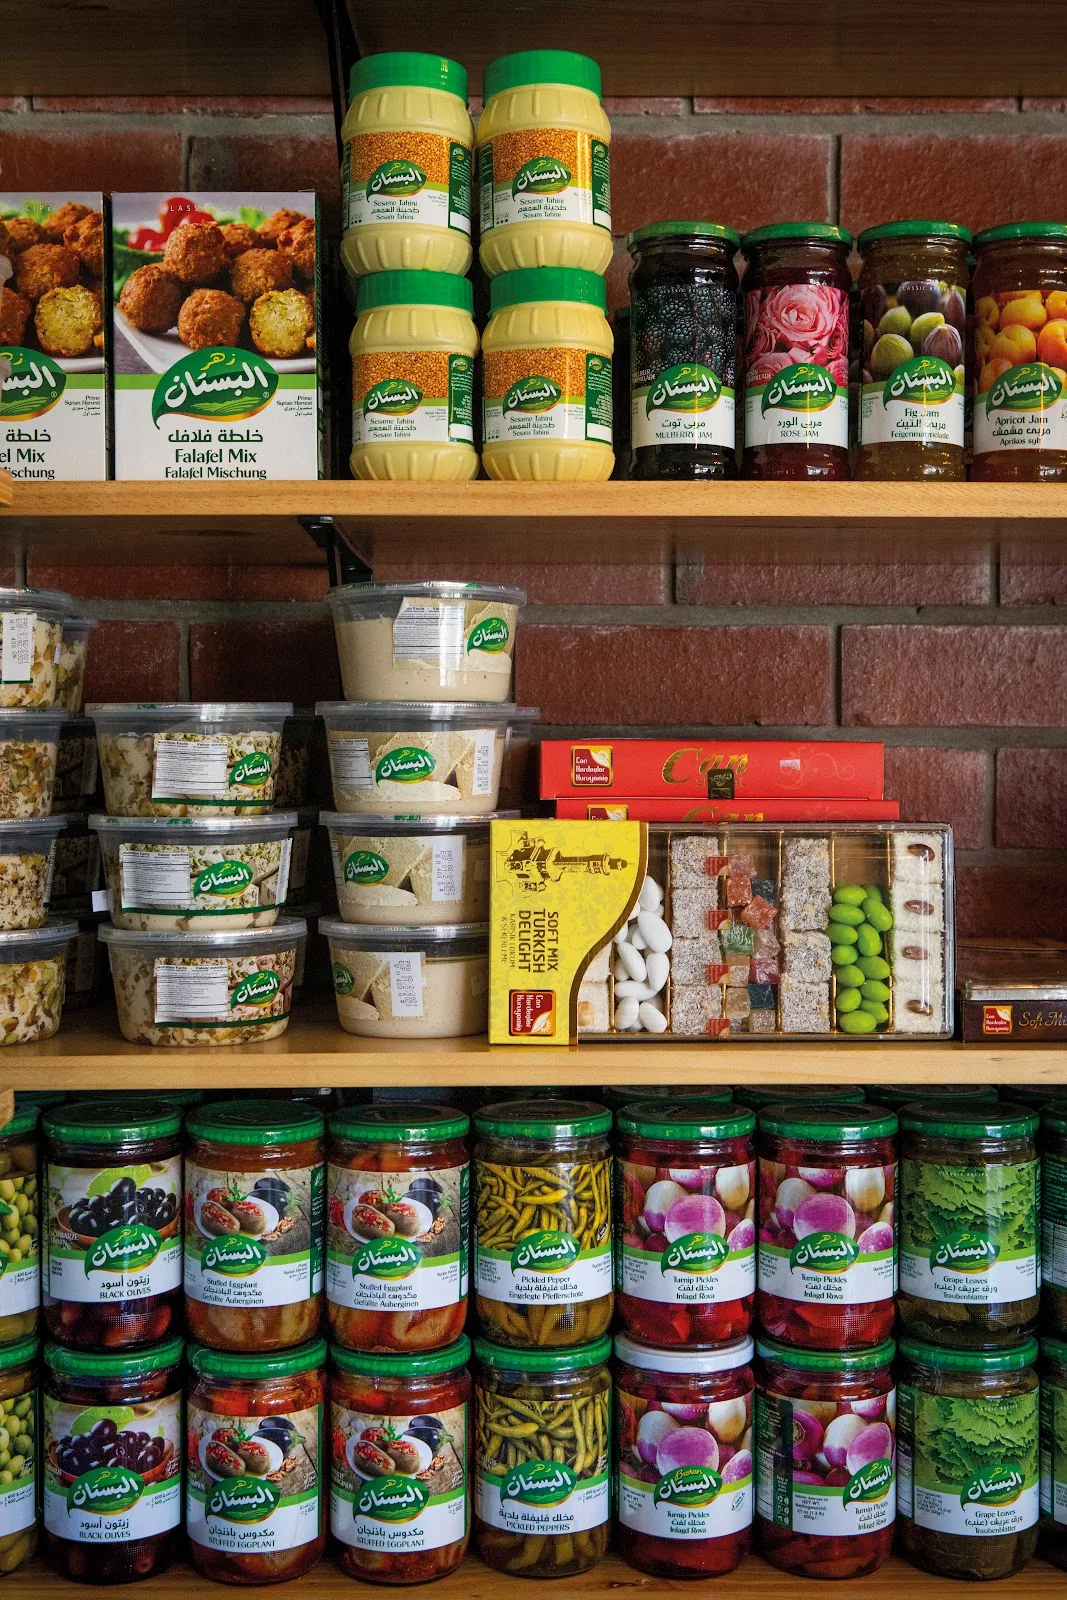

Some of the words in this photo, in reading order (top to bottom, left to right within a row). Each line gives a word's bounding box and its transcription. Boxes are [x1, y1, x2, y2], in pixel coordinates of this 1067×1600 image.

[371, 168, 421, 192] البستان
[517, 165, 567, 190] البستان
[518, 205, 540, 213] السمسم
[200, 352, 235, 371] زهر
[164, 362, 269, 408] البستان
[653, 375, 716, 405] البستان
[768, 376, 832, 404] البستان
[891, 367, 953, 396] البستان
[992, 374, 1058, 406] البستان
[368, 388, 418, 409] البستان
[508, 384, 557, 408] البستان
[905, 408, 918, 418] Fig
[995, 416, 1026, 425] Apricot
[1029, 416, 1047, 424] Jam
[6, 429, 51, 442] خلطة
[168, 429, 212, 442] فلافل
[219, 429, 263, 442] خلطة
[781, 430, 800, 438] ROSE
[803, 430, 818, 438] JAM
[1000, 438, 1026, 446] Aprikos
[17, 449, 45, 462] Mix
[175, 449, 222, 464] Falafel
[228, 449, 256, 462] Mix
[165, 467, 203, 479] Falafel
[208, 467, 266, 480] Mischung
[473, 626, 507, 646] البستان
[235, 762, 270, 782] البستان
[381, 757, 431, 777] البستان
[200, 867, 249, 891] البستان
[547, 912, 559, 945] SOFT
[519, 911, 531, 972] DELIGHT
[533, 909, 545, 973] TURKISH
[547, 947, 559, 971] MIX
[237, 977, 278, 1002] البستان
[92, 1234, 157, 1266] البستان
[206, 1244, 261, 1266] البستان
[358, 1246, 415, 1271] البستان
[517, 1239, 575, 1265] البستان
[668, 1241, 725, 1266] البستان
[797, 1241, 854, 1263] البستان
[936, 1240, 995, 1263] البستان
[101, 1275, 123, 1288] أسود
[127, 1275, 149, 1287] زيتون
[207, 1279, 227, 1287] Stuffed
[229, 1281, 257, 1289] Eggplant
[547, 1276, 570, 1284] Pepper
[802, 1274, 821, 1282] Turnip
[944, 1276, 963, 1284] Grape
[100, 1290, 124, 1299] BLACK
[127, 1287, 151, 1297] OLIVES
[509, 1291, 540, 1299] Eingelegte
[73, 1477, 138, 1504] البستان
[507, 1470, 571, 1496] البستان
[660, 1474, 716, 1498] البستان
[850, 1465, 891, 1498] البستان
[968, 1472, 1022, 1499] البستان
[211, 1487, 274, 1512] البستان
[359, 1486, 423, 1512] البستان
[667, 1511, 686, 1519] Turnip
[998, 1509, 1016, 1517] Leaves
[80, 1517, 101, 1529] أسود
[105, 1519, 129, 1529] زيتون
[210, 1527, 236, 1538] باذنجان
[358, 1526, 385, 1537] باذنجان
[506, 1521, 535, 1531] PICKLED
[104, 1531, 130, 1539] OLIVES
[209, 1537, 235, 1547] STUFFED
[238, 1540, 275, 1548] EGGPLANT
[239, 1528, 274, 1539] مكدوس
[357, 1537, 385, 1547] STUFFED
[387, 1539, 425, 1547] EGGPLANT
[389, 1528, 423, 1539] مكدوس
